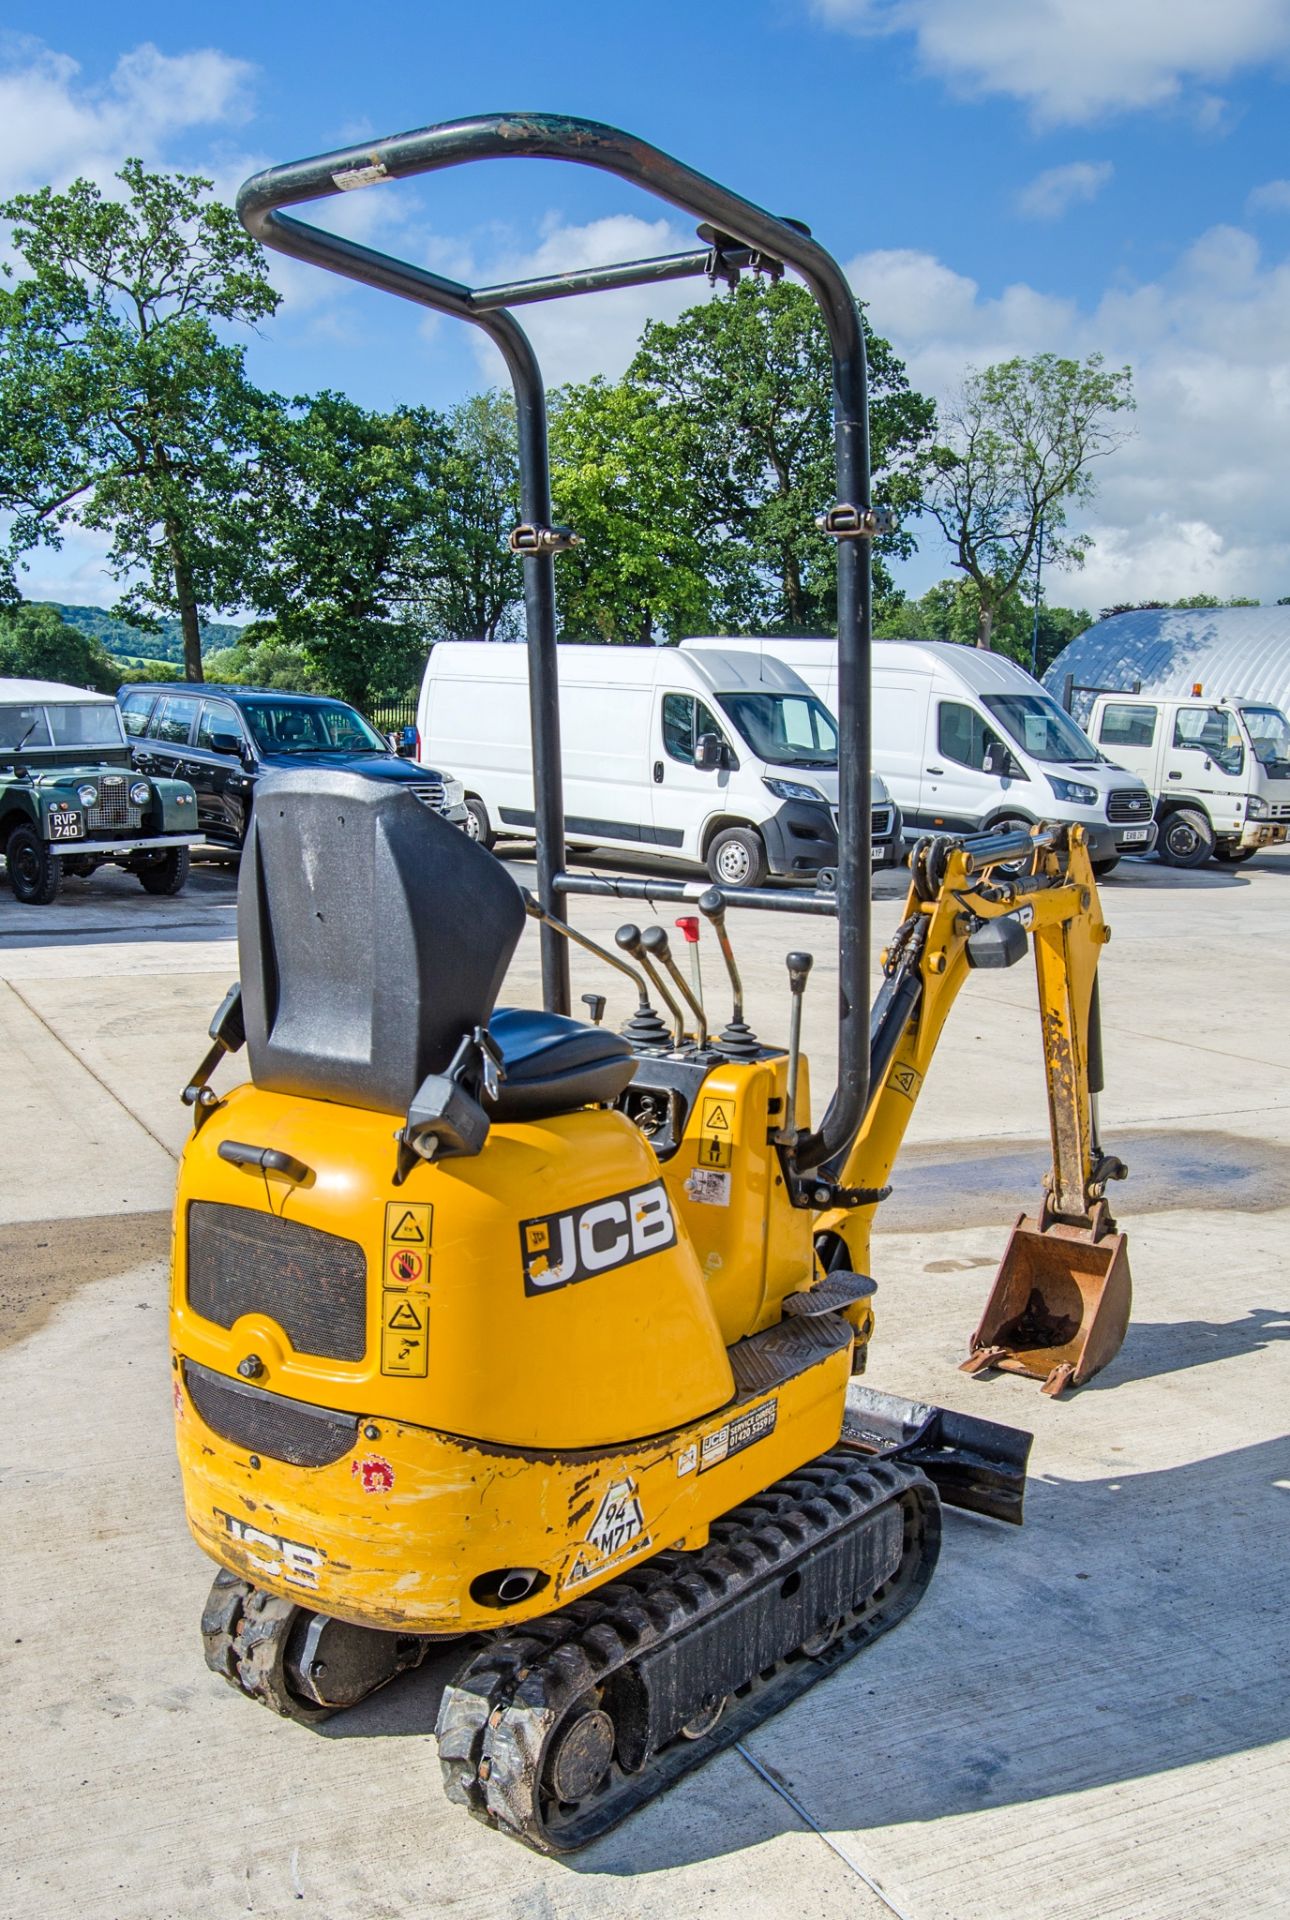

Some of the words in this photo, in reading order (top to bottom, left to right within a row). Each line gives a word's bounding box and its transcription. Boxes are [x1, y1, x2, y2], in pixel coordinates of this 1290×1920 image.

[53, 813, 77, 826] RVP
[54, 825, 78, 838] 740
[529, 1186, 674, 1287] JCB
[730, 1416, 754, 1436] SERVICE
[755, 1404, 777, 1421] DIRECT
[704, 1430, 727, 1451] JCB
[729, 1427, 751, 1446] 01420
[605, 1497, 626, 1529] 94
